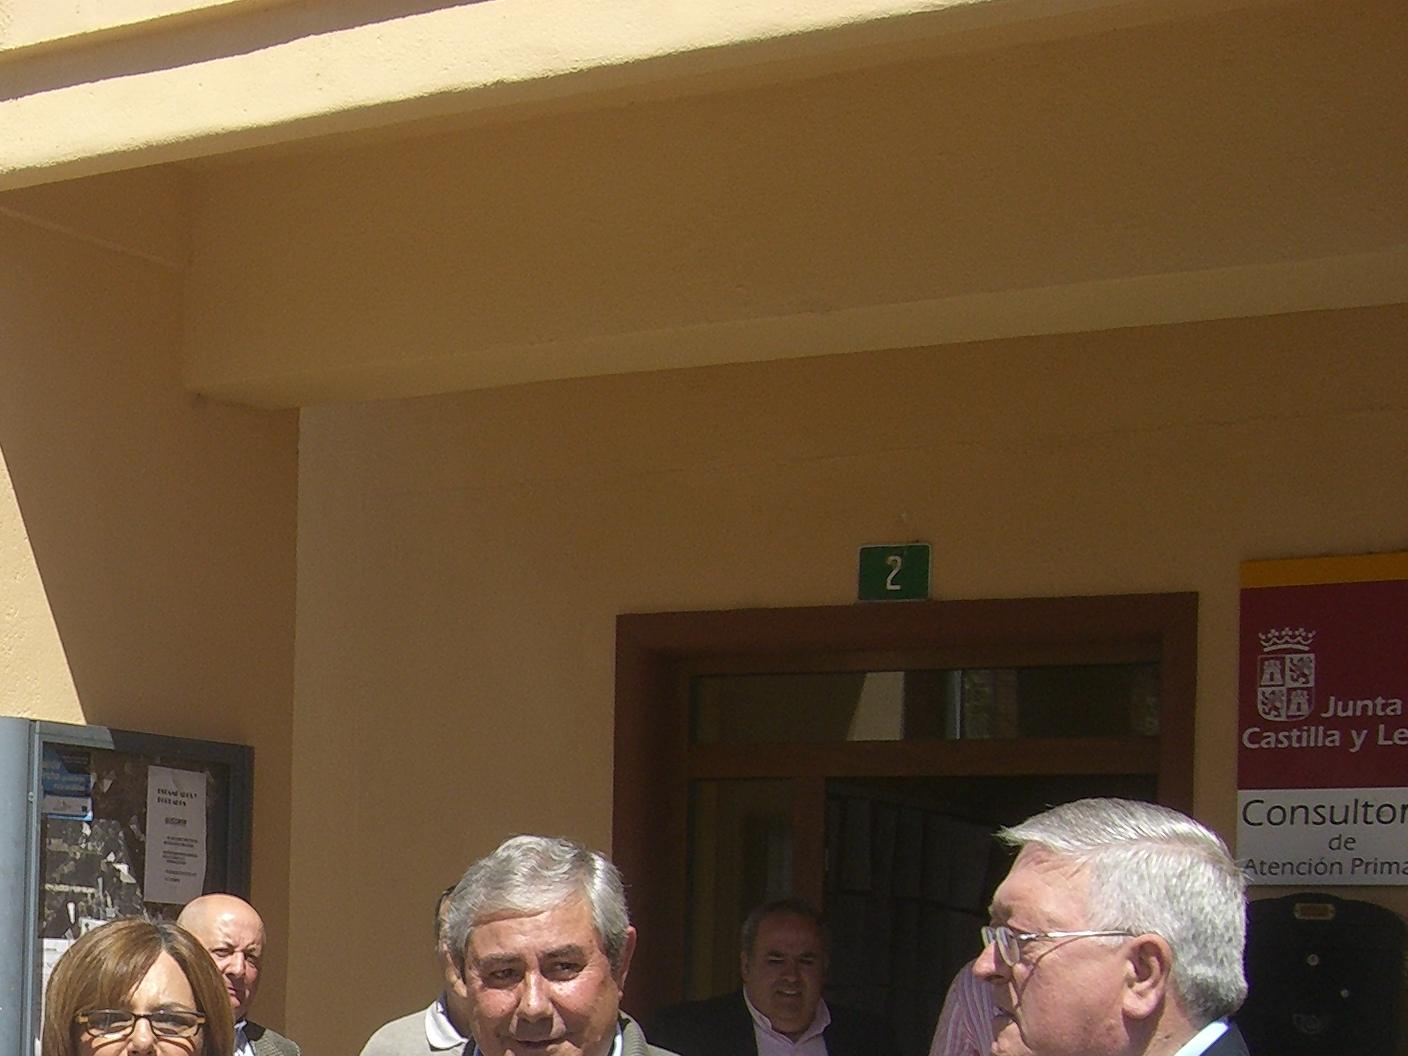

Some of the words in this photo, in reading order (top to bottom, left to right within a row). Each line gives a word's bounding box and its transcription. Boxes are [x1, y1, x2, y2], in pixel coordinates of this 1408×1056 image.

[886, 555, 902, 590] 2
[1320, 695, 1403, 717] Junta
[1242, 726, 1340, 748] Castilla
[1349, 729, 1368, 752] y
[1377, 724, 1408, 745] Le
[1328, 833, 1356, 851] de
[1244, 857, 1343, 876] Atención
